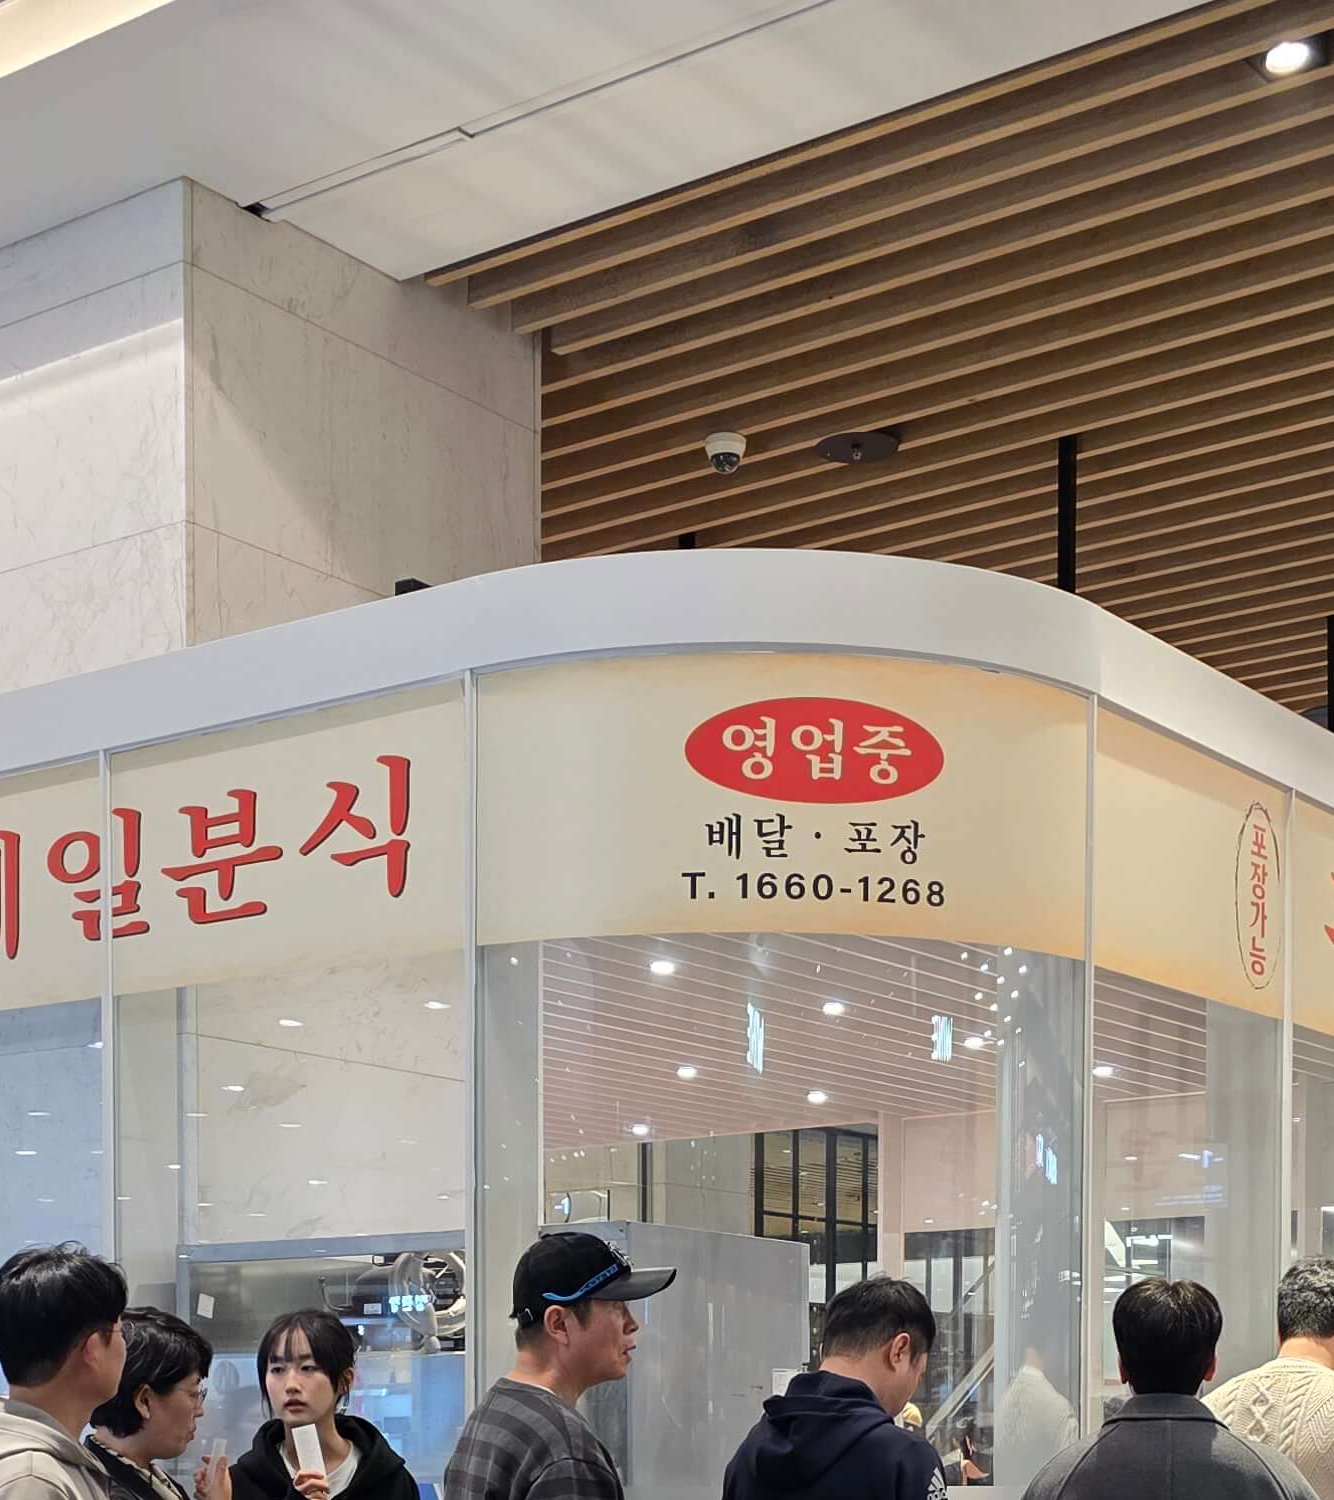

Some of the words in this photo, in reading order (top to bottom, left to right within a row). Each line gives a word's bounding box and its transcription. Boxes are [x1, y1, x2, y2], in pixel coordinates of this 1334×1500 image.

[722, 716, 912, 785] 영업중
[705, 813, 793, 860] 배달
[844, 820, 926, 865] 포장
[681, 872, 716, 900] T.
[735, 873, 946, 907] 1660-1268
[1249, 824, 1268, 977] 포장가능
